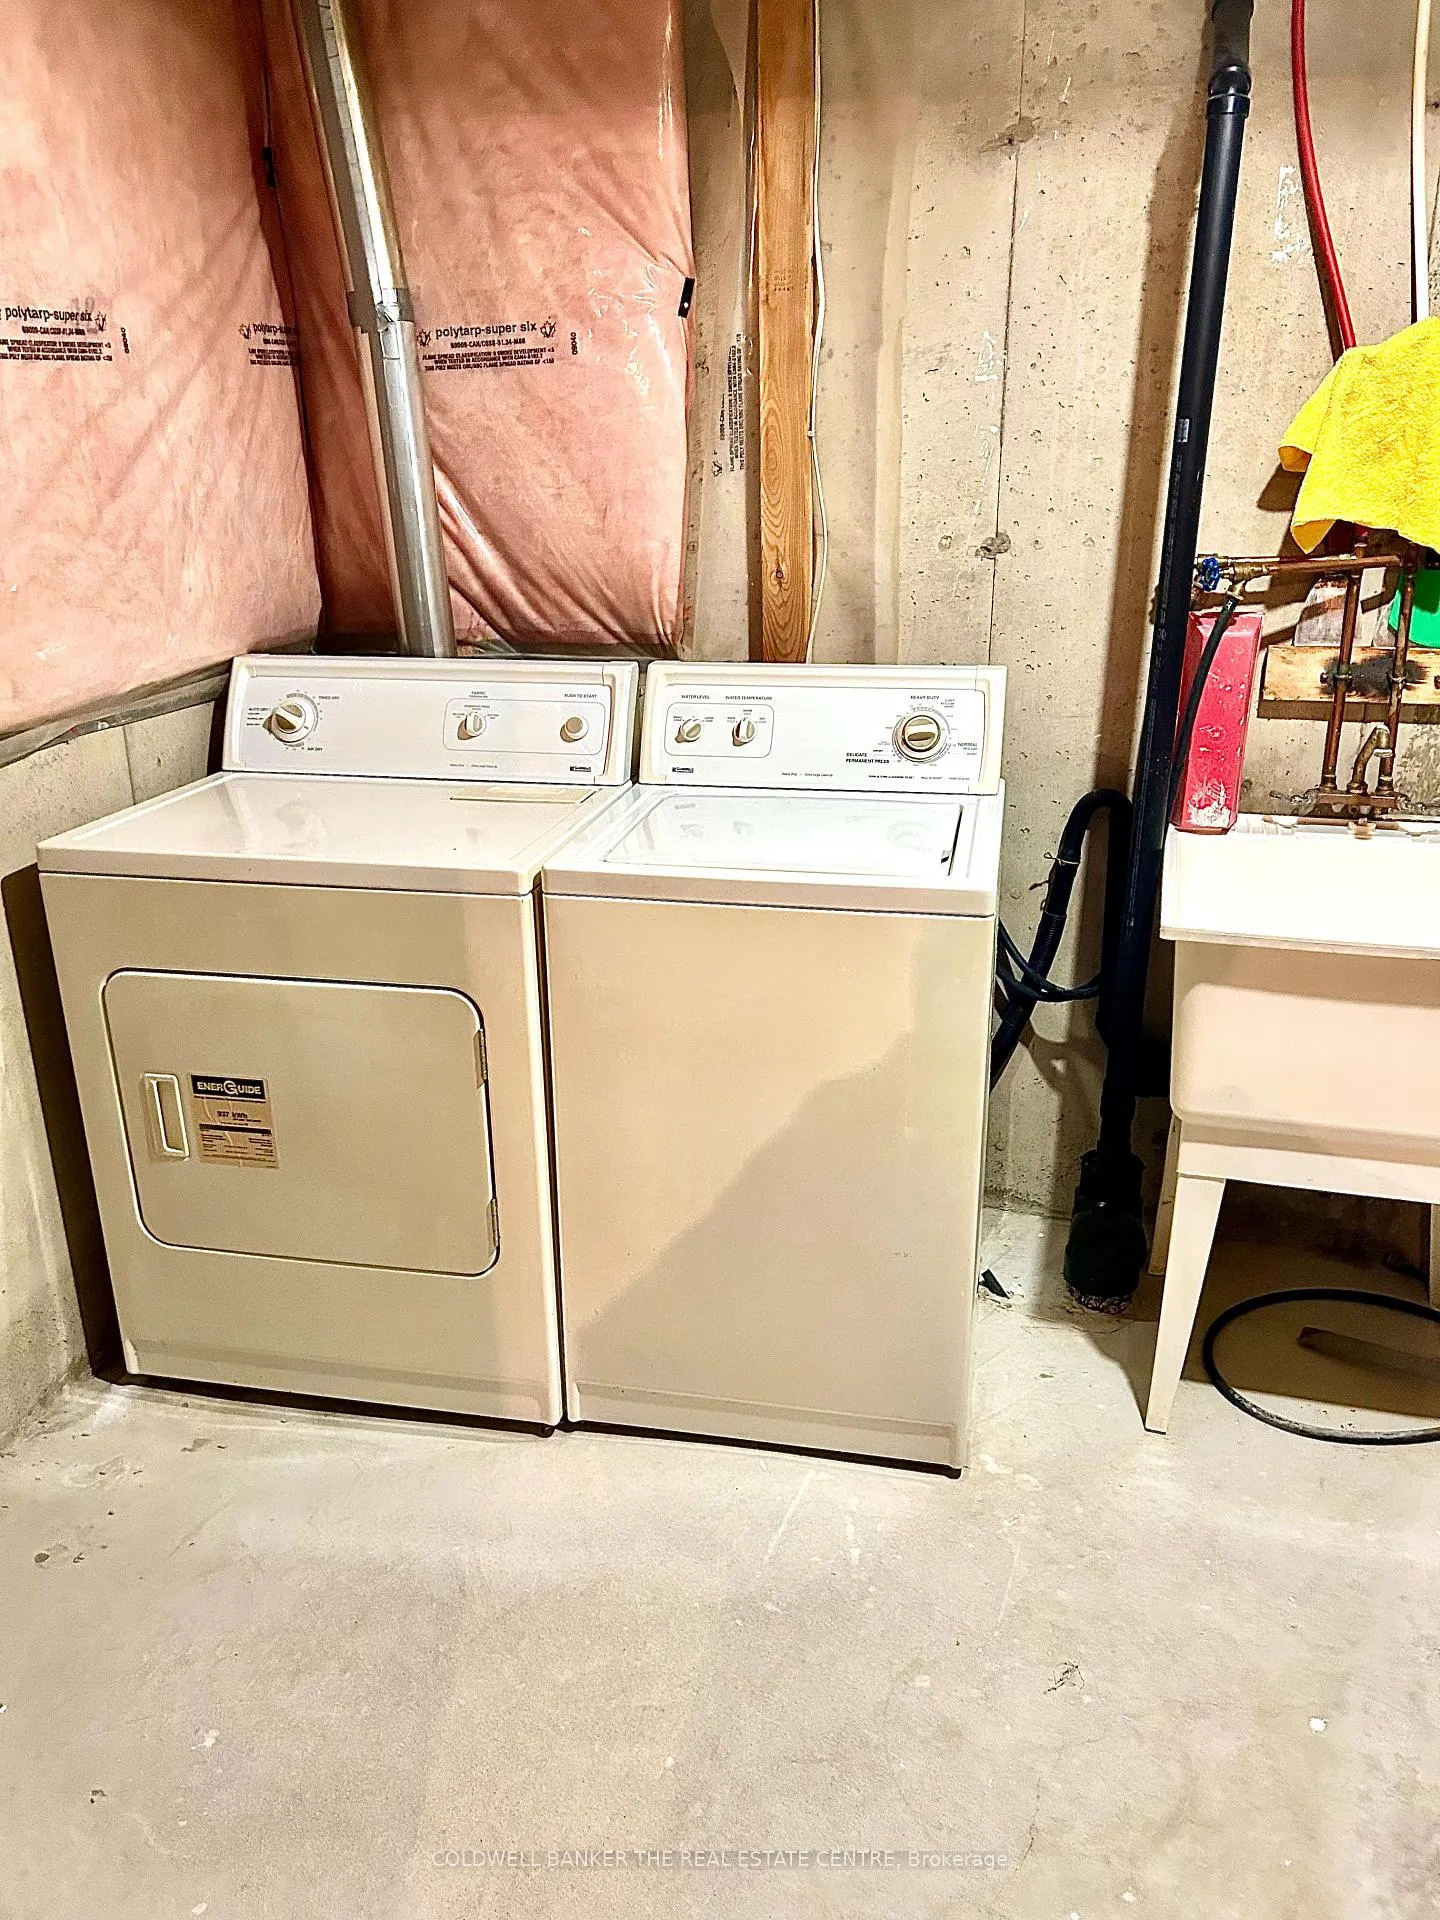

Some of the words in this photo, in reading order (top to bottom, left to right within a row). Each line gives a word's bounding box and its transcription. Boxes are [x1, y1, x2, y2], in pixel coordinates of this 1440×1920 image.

[5, 306, 79, 324] polytarp-super
[80, 310, 92, 321] six
[436, 324, 516, 340] polytarp-super
[520, 321, 537, 332] six
[197, 1080, 262, 1095] ENERGUIDE
